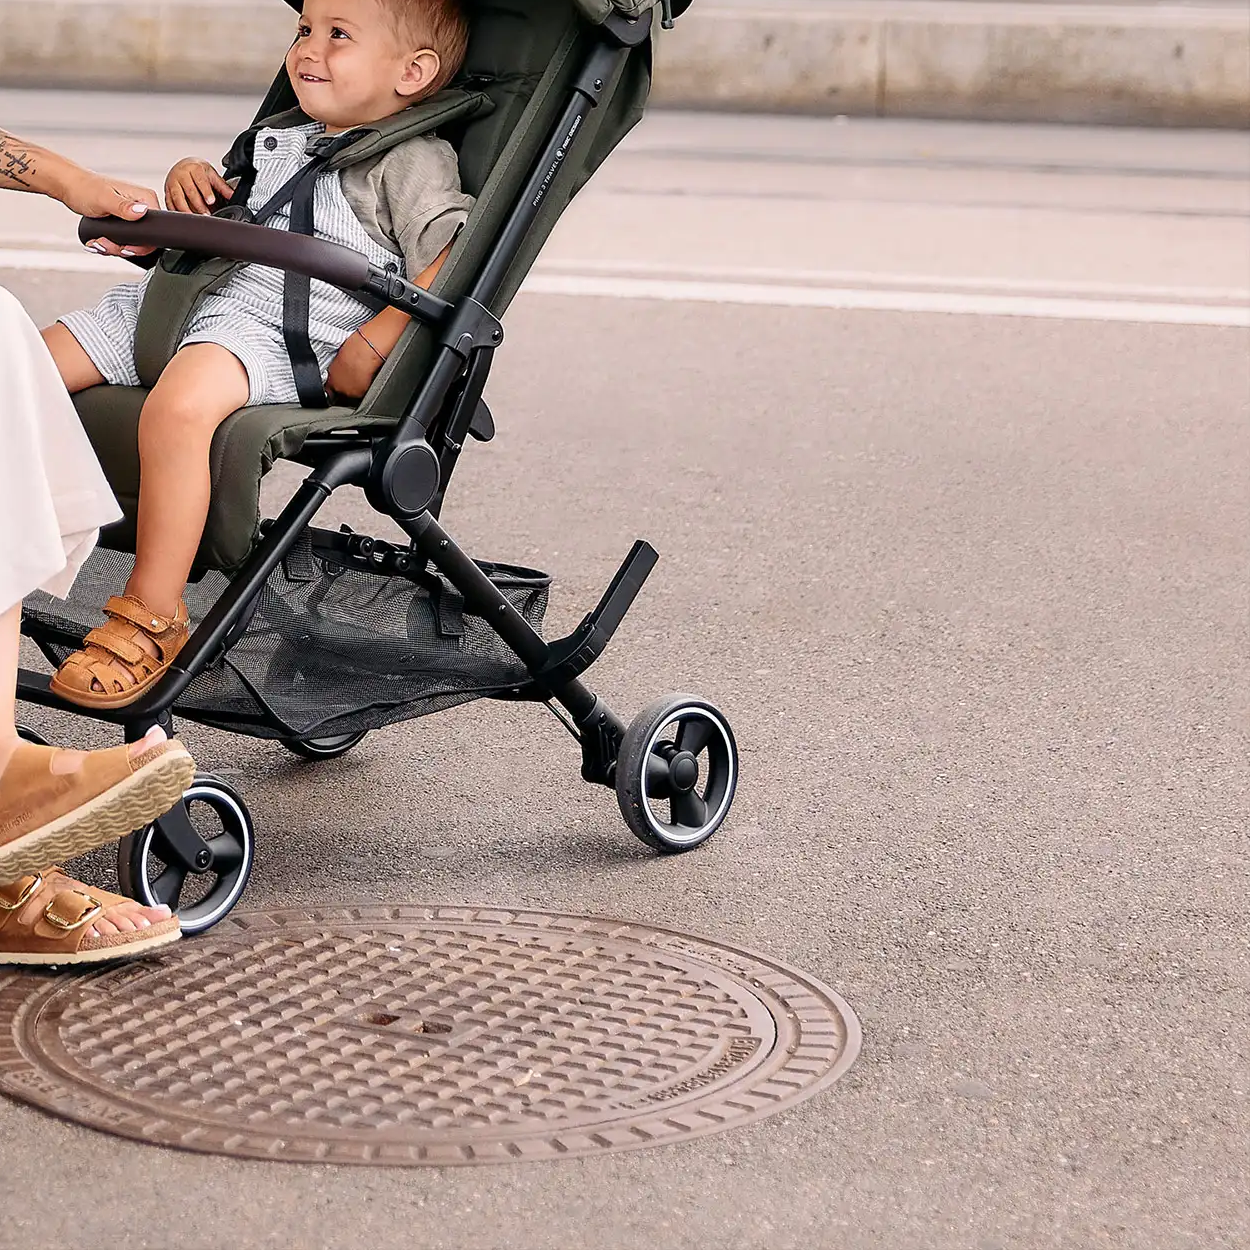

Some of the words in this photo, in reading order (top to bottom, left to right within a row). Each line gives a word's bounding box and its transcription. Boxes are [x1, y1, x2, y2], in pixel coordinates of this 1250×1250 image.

[562, 136, 571, 150] ABC
[569, 114, 582, 137] DESIGN
[532, 190, 544, 207] PING
[544, 160, 559, 184] TRAVEL
